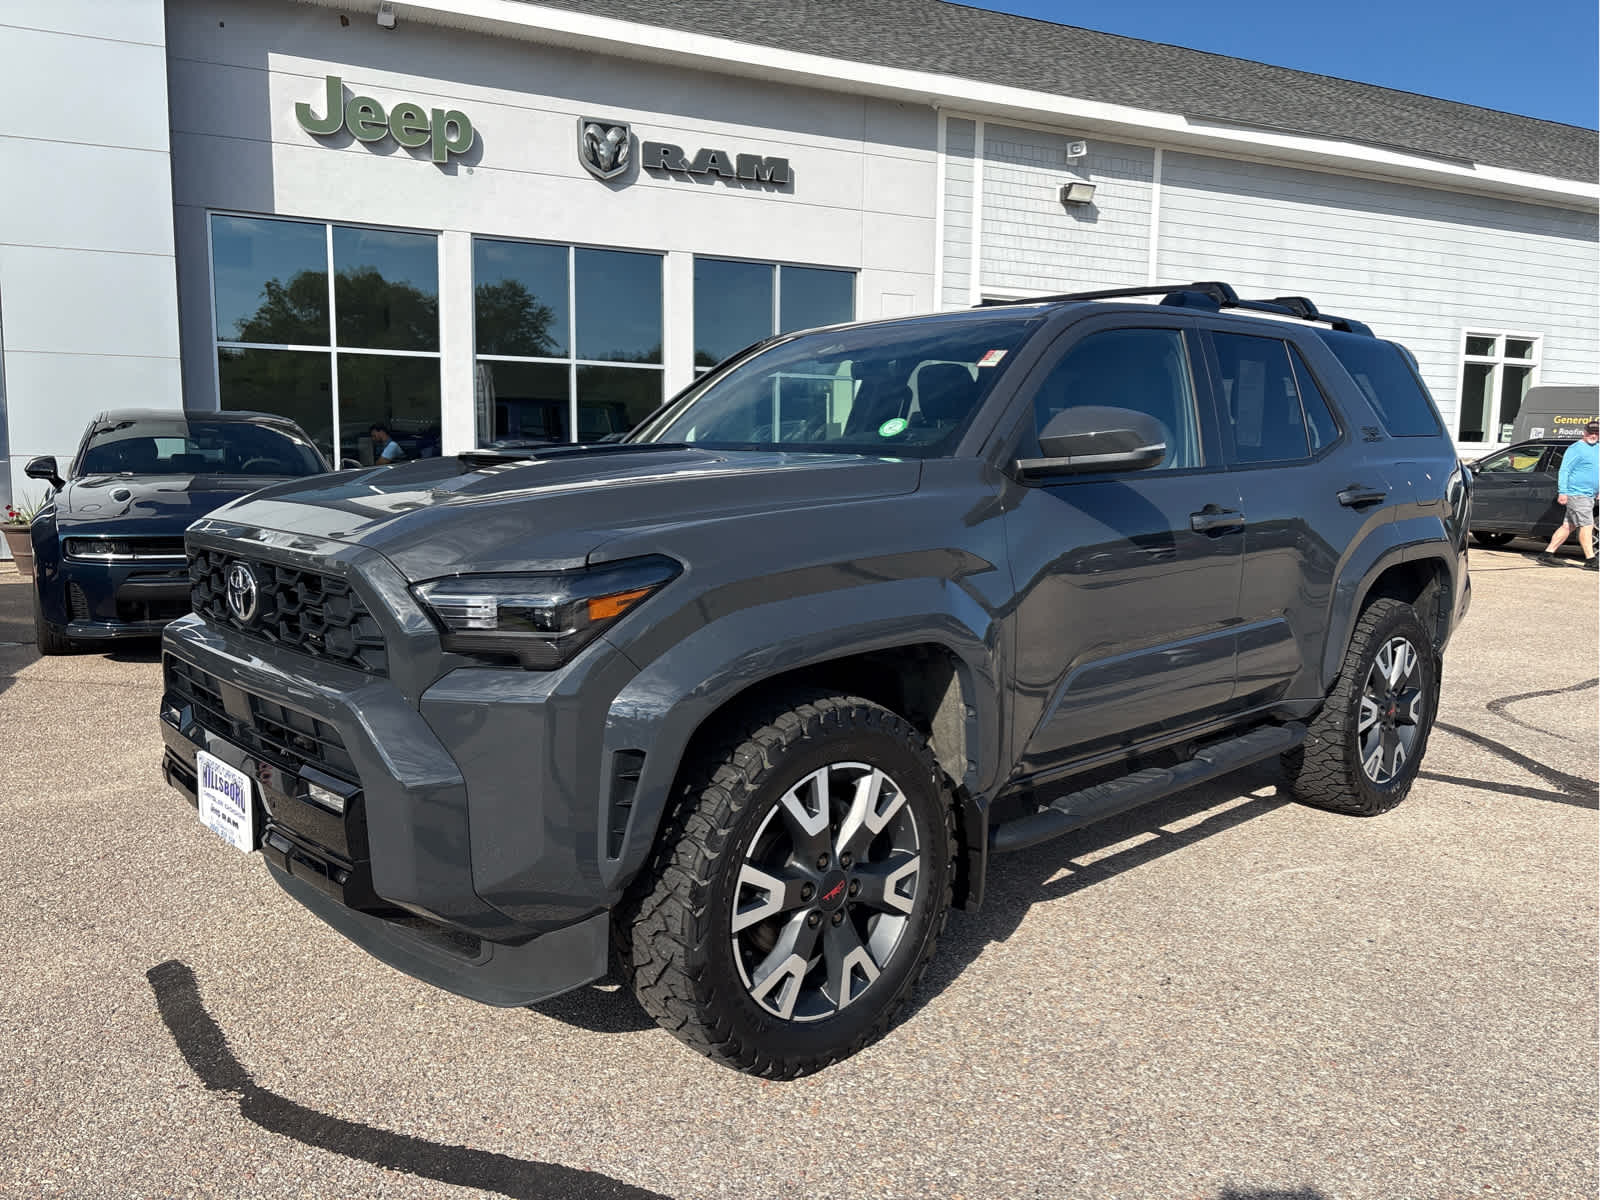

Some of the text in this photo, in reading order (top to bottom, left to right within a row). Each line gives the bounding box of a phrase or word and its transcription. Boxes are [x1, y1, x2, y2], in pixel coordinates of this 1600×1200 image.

[295, 75, 473, 163] Jeep
[642, 141, 790, 183] RAM
[1554, 416, 1592, 424] General
[1559, 428, 1585, 436] Roofin
